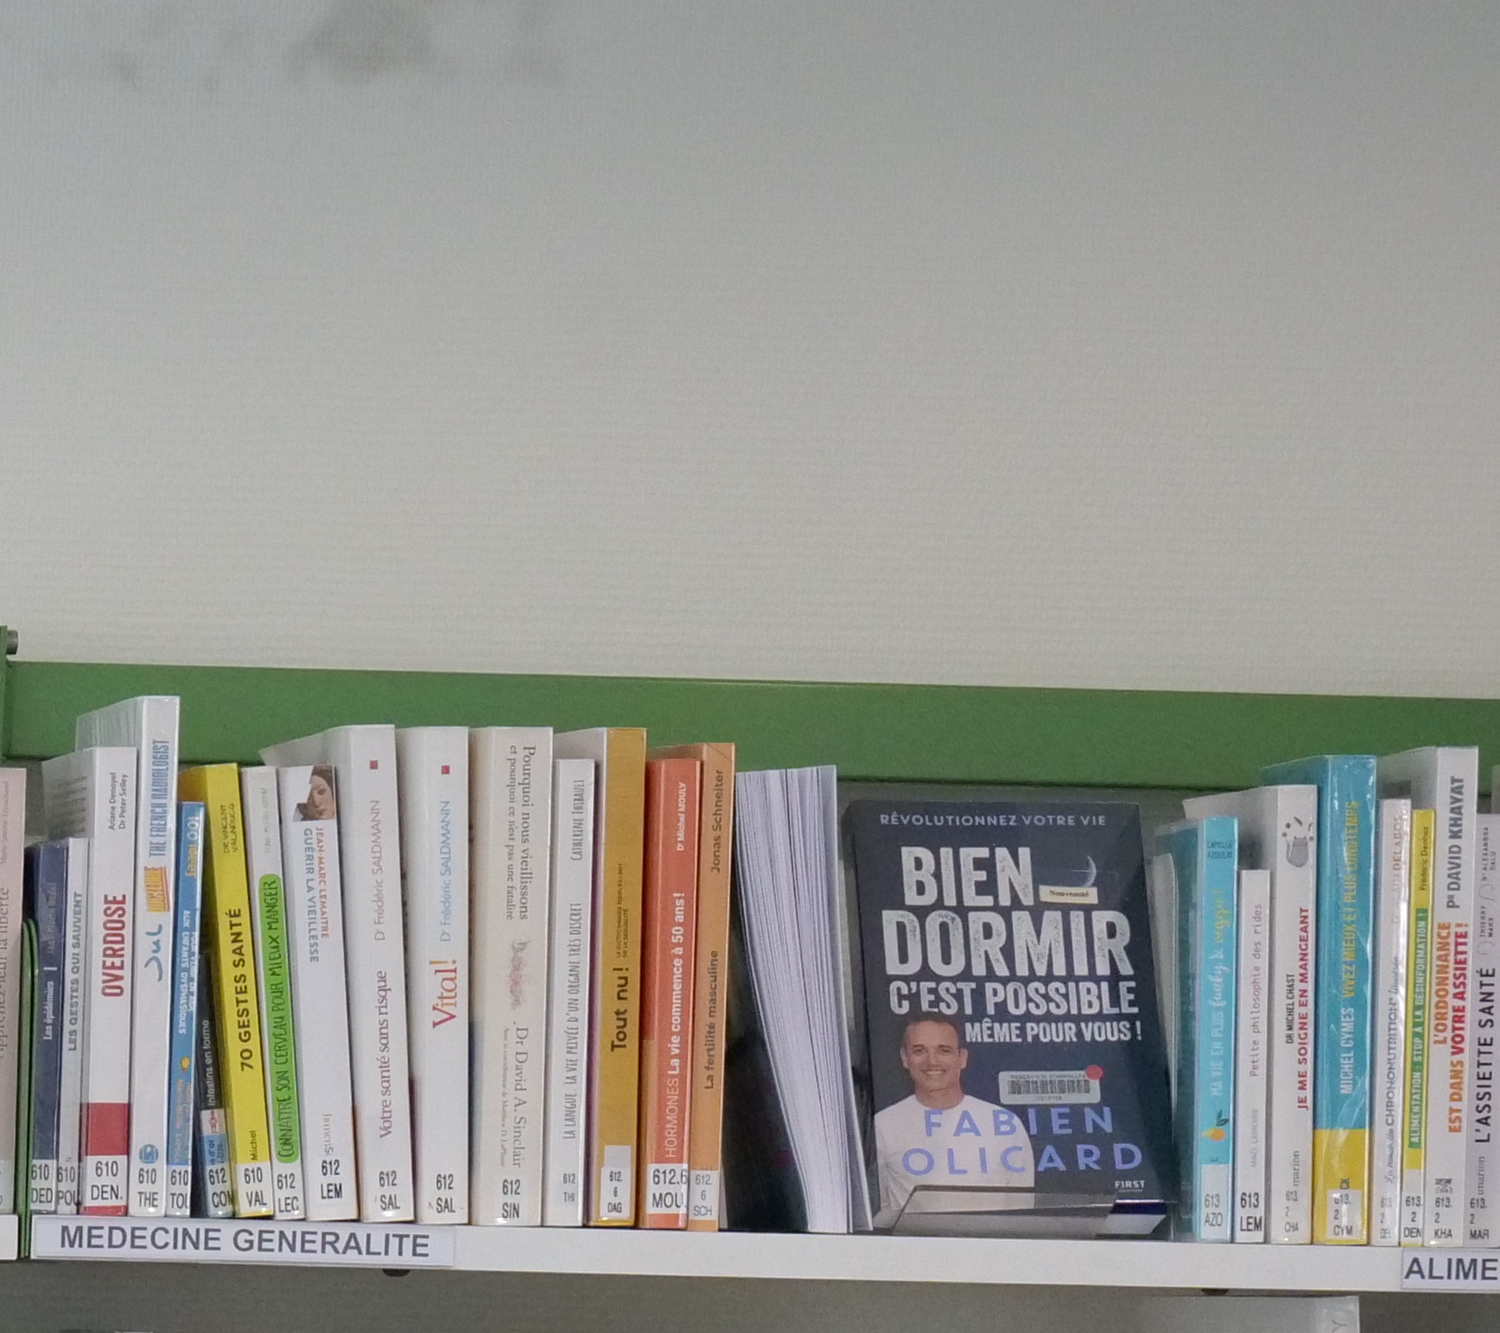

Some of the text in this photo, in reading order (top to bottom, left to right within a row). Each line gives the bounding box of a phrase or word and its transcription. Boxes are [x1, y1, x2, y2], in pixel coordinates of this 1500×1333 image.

[1022, 815, 1075, 826] VOTRE
[1082, 816, 1106, 827] VIE
[900, 846, 1035, 907] BIEN
[101, 894, 127, 998] OVERDOSE
[881, 909, 1135, 977] DORMIR
[225, 907, 254, 1072] 70 GESTES SANTÉ
[888, 981, 1139, 1015] C'EST POSSIBLE
[964, 1018, 1022, 1043] MÊME
[1026, 1021, 1077, 1043] POUR
[1082, 1021, 1131, 1042] VOUS
[1475, 967, 1496, 1143] L'ASSIETTE SANTÉ
[924, 1106, 1114, 1138] FABIEN
[902, 1143, 1143, 1177] OLICARD
[502, 1178, 521, 1196] 612
[1115, 1180, 1145, 1189] FIRST
[502, 1202, 520, 1219] SIN
[59, 1226, 431, 1258] MEDECINE GENERALITE
